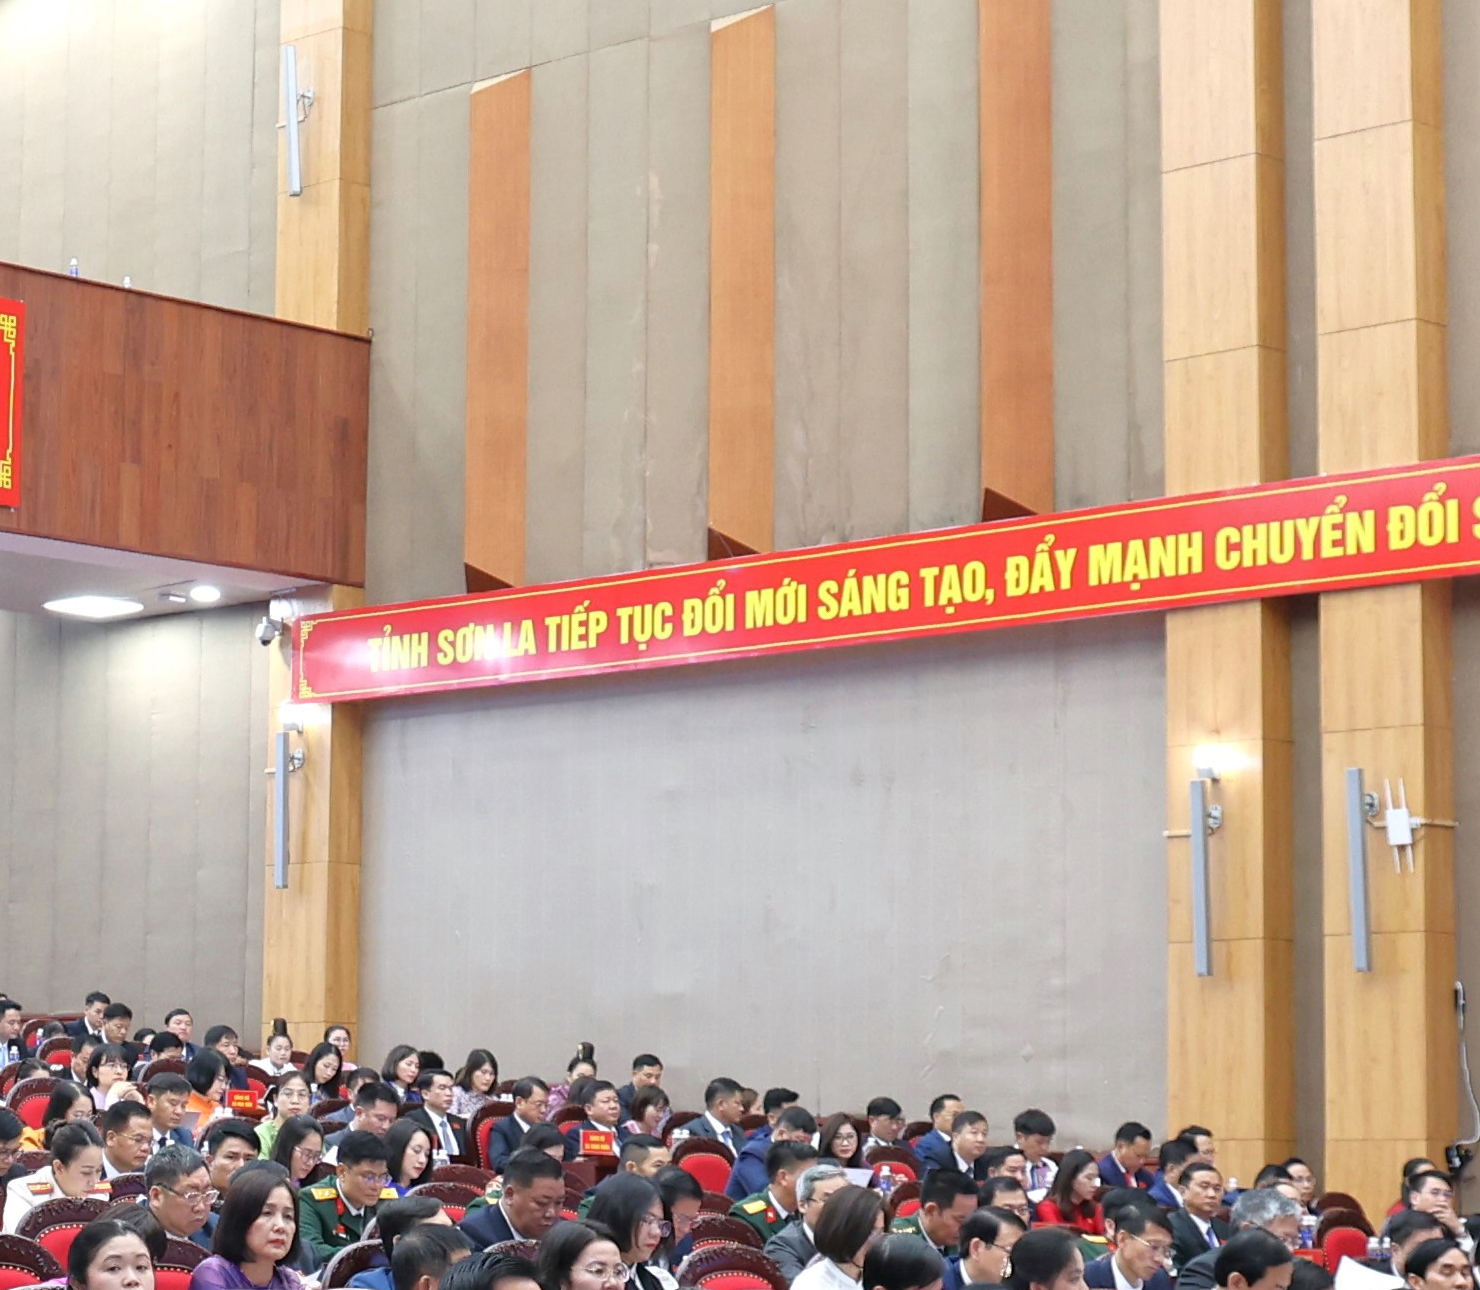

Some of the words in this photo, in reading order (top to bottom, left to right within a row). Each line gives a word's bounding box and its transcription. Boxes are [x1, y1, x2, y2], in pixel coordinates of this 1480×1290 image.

[367, 624, 429, 673] TỈNH
[544, 599, 608, 653] TIẾP
[616, 601, 673, 649] TỤC
[681, 579, 735, 636] ĐỔI
[745, 573, 807, 629] MỚI
[817, 559, 910, 620] SÁNG
[919, 560, 1004, 615] TẠO,
[1004, 533, 1077, 597] ĐẨY
[1088, 531, 1203, 596] MẠNH
[1215, 495, 1375, 570] CHUYỂN
[1386, 482, 1459, 551] ĐỔI
